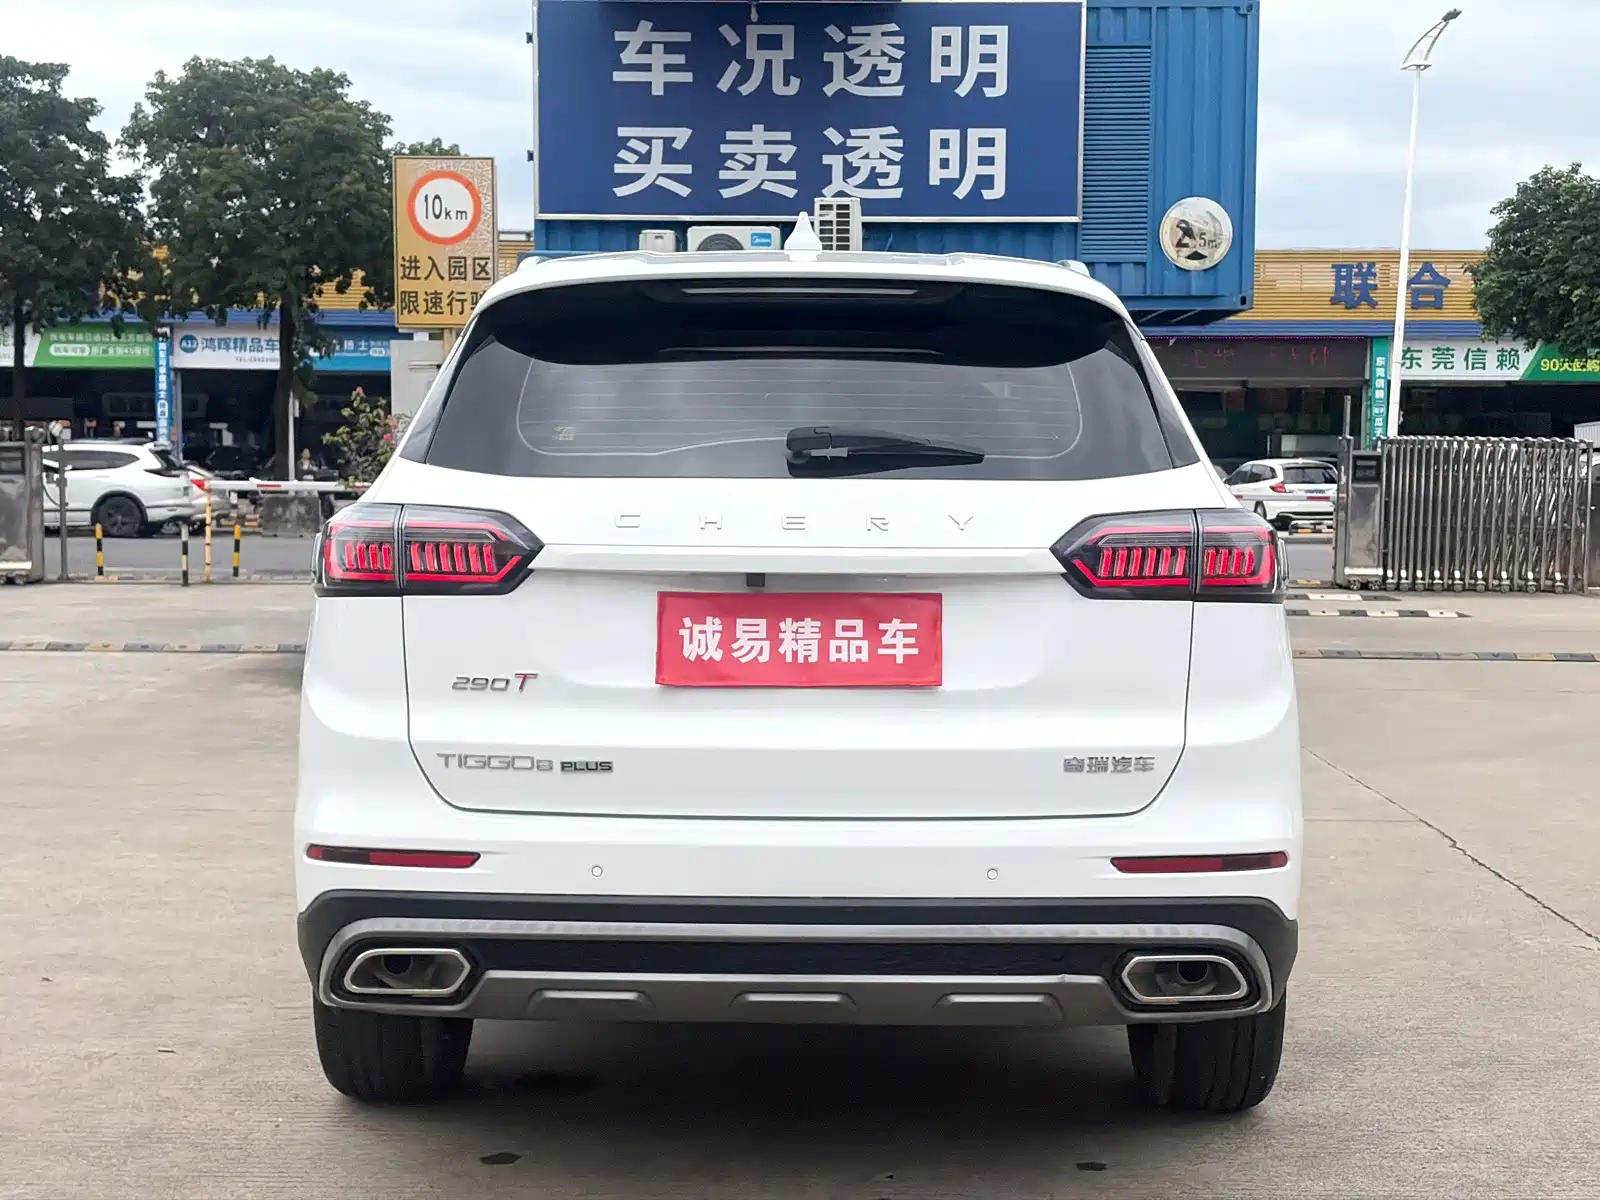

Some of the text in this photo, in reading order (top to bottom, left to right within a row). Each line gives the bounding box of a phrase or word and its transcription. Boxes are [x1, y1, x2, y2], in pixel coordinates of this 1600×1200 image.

[612, 19, 1009, 98] 车况透明
[612, 124, 1008, 200] 买卖透明
[400, 255, 492, 281] 进入园区
[1330, 261, 1451, 309] 联合
[1401, 346, 1521, 371] 东莞信赖
[614, 512, 975, 532] CHERY
[678, 616, 920, 664] 诚易精品车
[560, 760, 614, 773] PLUS
[1063, 756, 1156, 774] 奇瑞汽车
